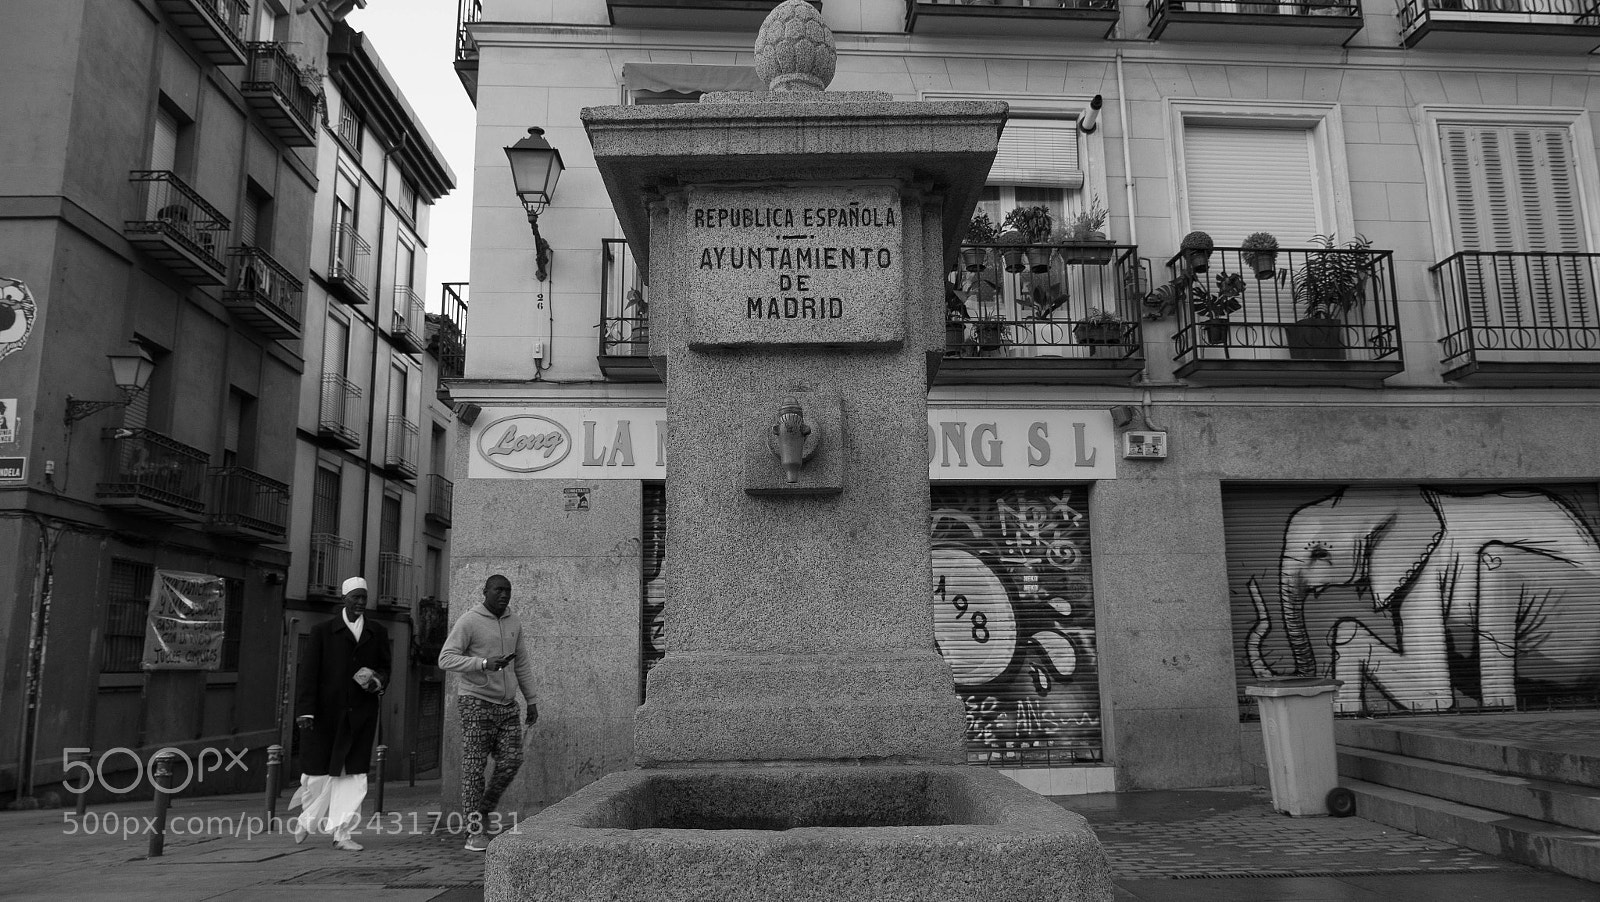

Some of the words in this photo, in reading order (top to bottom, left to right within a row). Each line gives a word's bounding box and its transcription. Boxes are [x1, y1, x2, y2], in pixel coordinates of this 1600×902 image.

[695, 208, 794, 228] REPUBLICA
[804, 202, 896, 228] ESPAÑOLA
[700, 248, 892, 270] AYUNTAMIENTO
[780, 275, 810, 291] DE
[747, 298, 843, 319] MADRID
[488, 424, 563, 458] Long
[582, 420, 635, 466] LA
[1028, 421, 1050, 467] S
[1073, 422, 1096, 467] L
